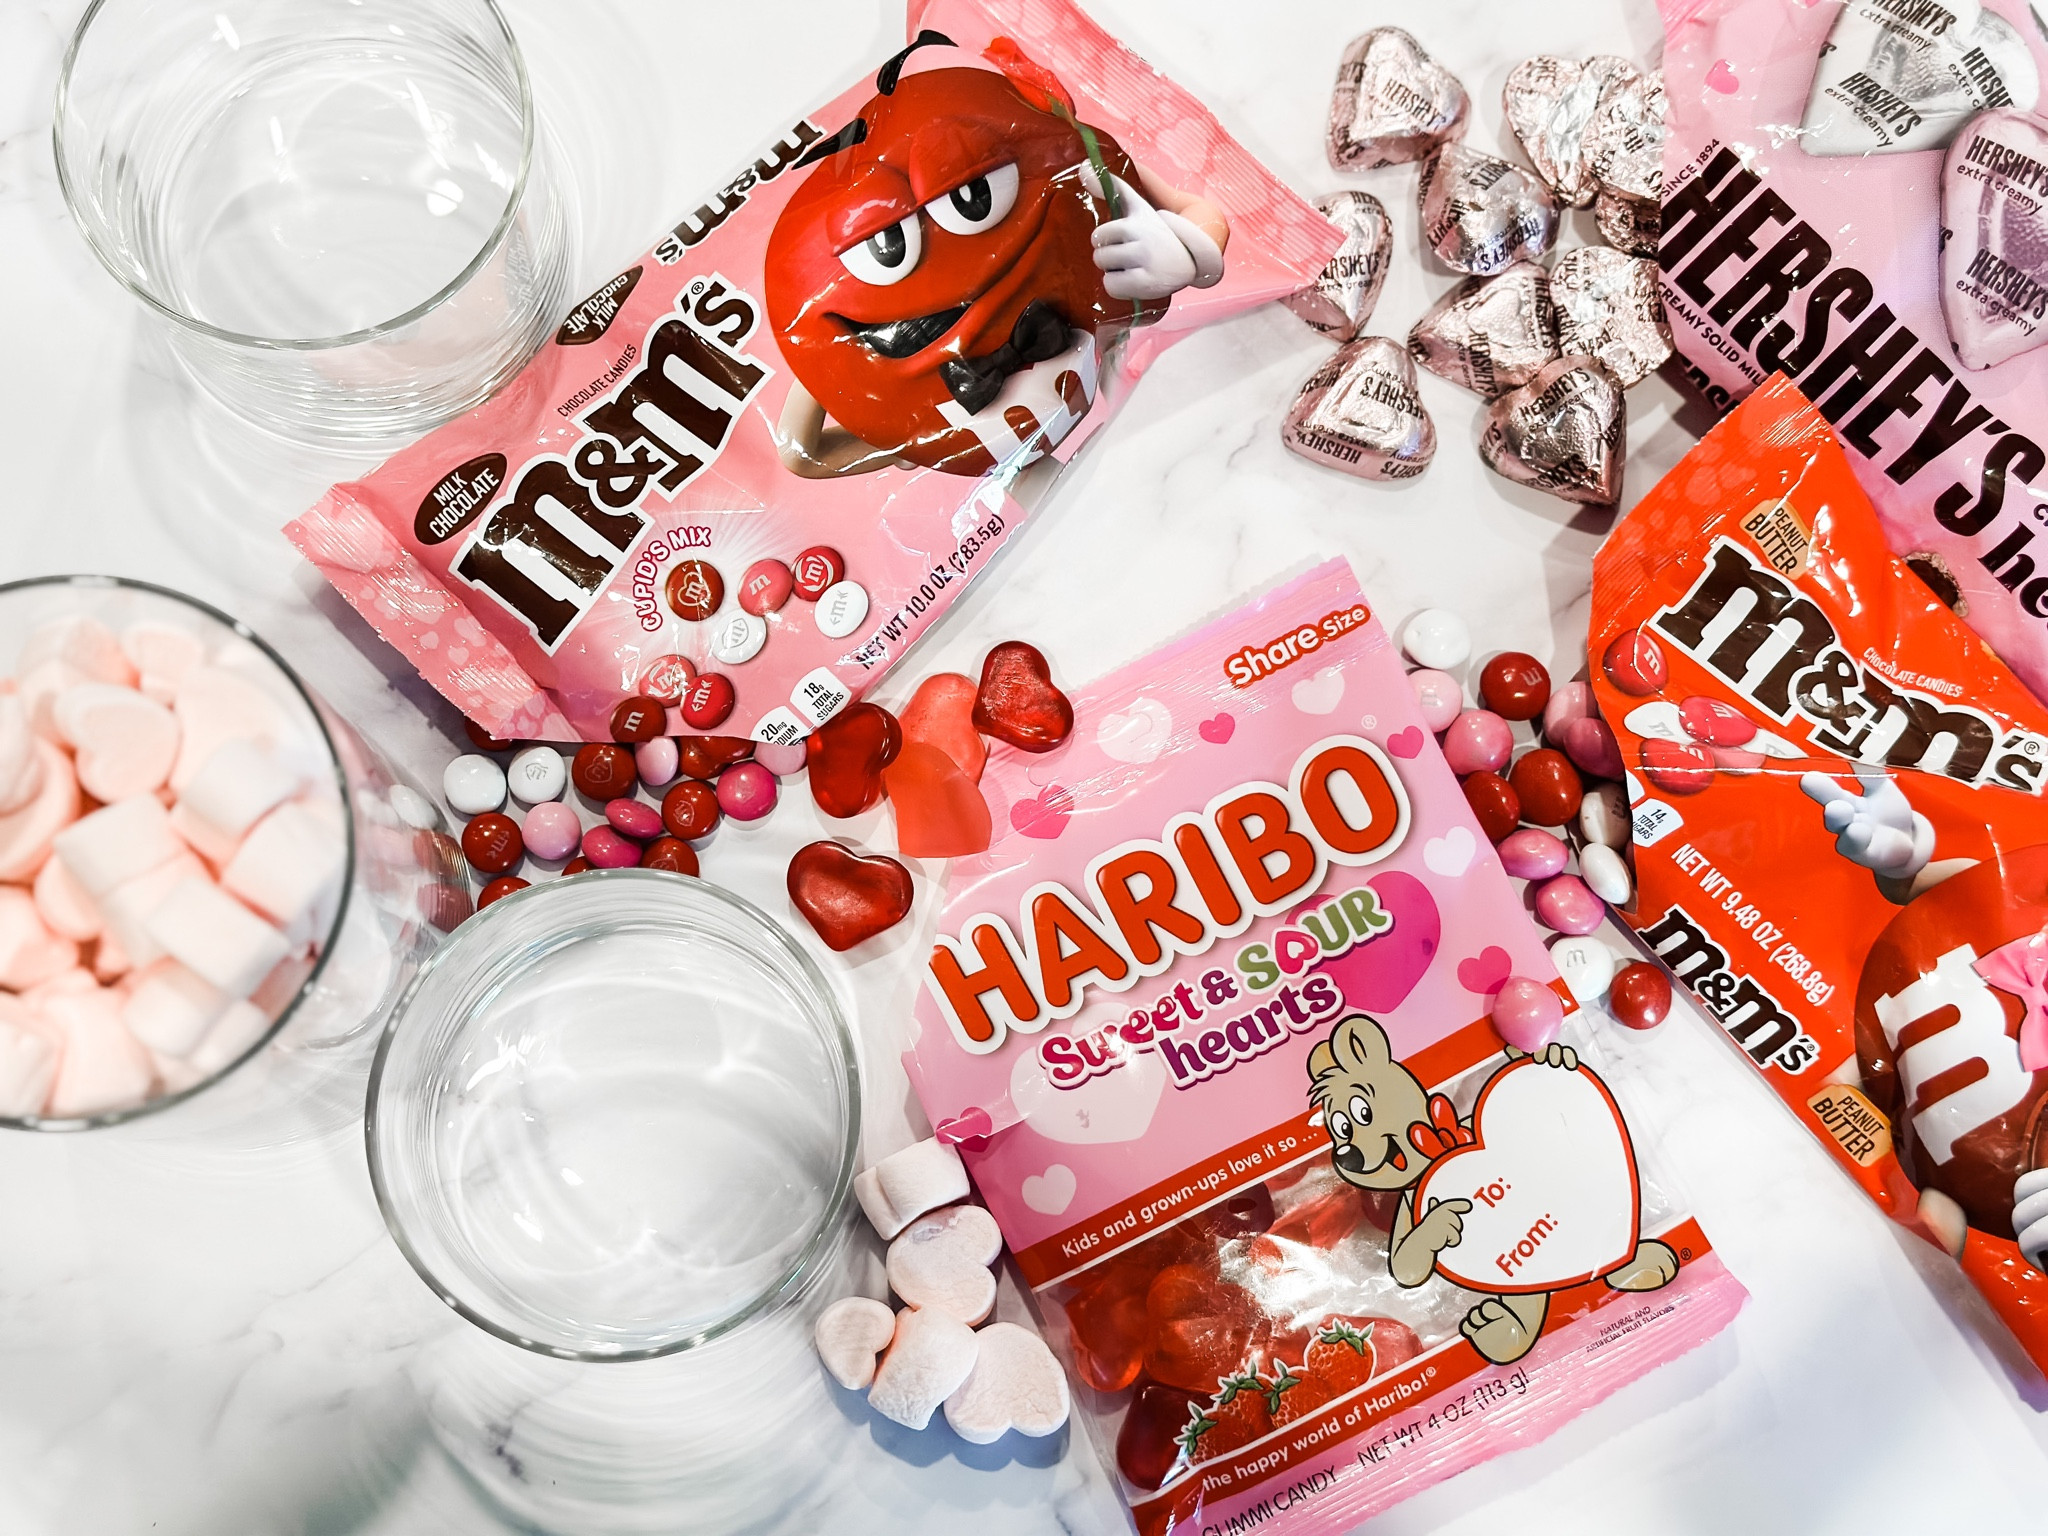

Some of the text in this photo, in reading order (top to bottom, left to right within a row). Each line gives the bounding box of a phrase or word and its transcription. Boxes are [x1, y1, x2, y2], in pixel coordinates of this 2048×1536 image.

[1891, 22, 1932, 53] creamy
[1837, 71, 1922, 138] HERSHEY'S
[1948, 63, 1974, 97] extra
[1825, 87, 1894, 148] extra creamy
[1660, 162, 1698, 198] SINCE
[1695, 138, 1720, 165] 1894
[1957, 163, 2043, 216] extra creamy
[563, 274, 628, 335] CHOCOLATE
[592, 296, 619, 331] MILK
[1956, 279, 2036, 337] extra creamy
[1966, 247, 2048, 321] HERSHEY'S
[1657, 281, 1703, 331] CREAMY
[1701, 327, 1740, 363] SOLID
[1658, 146, 2045, 537] HERSHEY'S
[557, 343, 637, 418] CHOCOLATE CANDIES
[429, 467, 499, 539] CHOCOLATE
[433, 471, 467, 507] MILK
[1744, 512, 1798, 575] BUTTER
[1774, 507, 1809, 553] PEANUT
[631, 526, 711, 632] CUPID'S MIX
[883, 615, 909, 642] WT
[905, 584, 936, 619] 10.0
[933, 563, 954, 591] OZ
[949, 514, 1005, 574] (283.5g)
[1228, 607, 1366, 685] Share Size
[1863, 647, 1963, 697] CHOCOLATE CANDIES
[624, 710, 644, 732] m
[811, 690, 834, 710] TOTAL
[816, 692, 844, 721] SUGARS
[928, 745, 1400, 1042] HARIBO
[1671, 843, 1835, 1007] NET WT 9.48 OZ (268.8g)
[1042, 889, 1389, 1080] Sweet & SOUR
[1159, 977, 1339, 1081] hearts
[1873, 943, 2032, 1167] m
[1812, 1097, 1877, 1162] BUTTER
[1837, 1095, 1885, 1136] PEANUT
[1061, 1231, 1100, 1258] Kids
[1103, 1210, 1137, 1238] and
[1140, 1168, 1228, 1223] grown-ups
[1227, 1152, 1263, 1176] love
[1262, 1143, 1276, 1160] it
[1278, 1137, 1297, 1152] so
[1473, 1177, 1511, 1208] To:
[1495, 1213, 1558, 1277] From:
[1634, 1306, 1651, 1320] AND
[1202, 1499, 1274, 1536] GUMMI
[1273, 1465, 1336, 1511] CANDY
[1357, 1434, 1392, 1469] NET
[1393, 1421, 1424, 1448] WT
[1428, 1413, 1441, 1430] 4
[1443, 1396, 1473, 1422] OZ
[1234, 1445, 1289, 1480] happy
[1293, 1417, 1342, 1452] world
[1344, 1405, 1362, 1426] of
